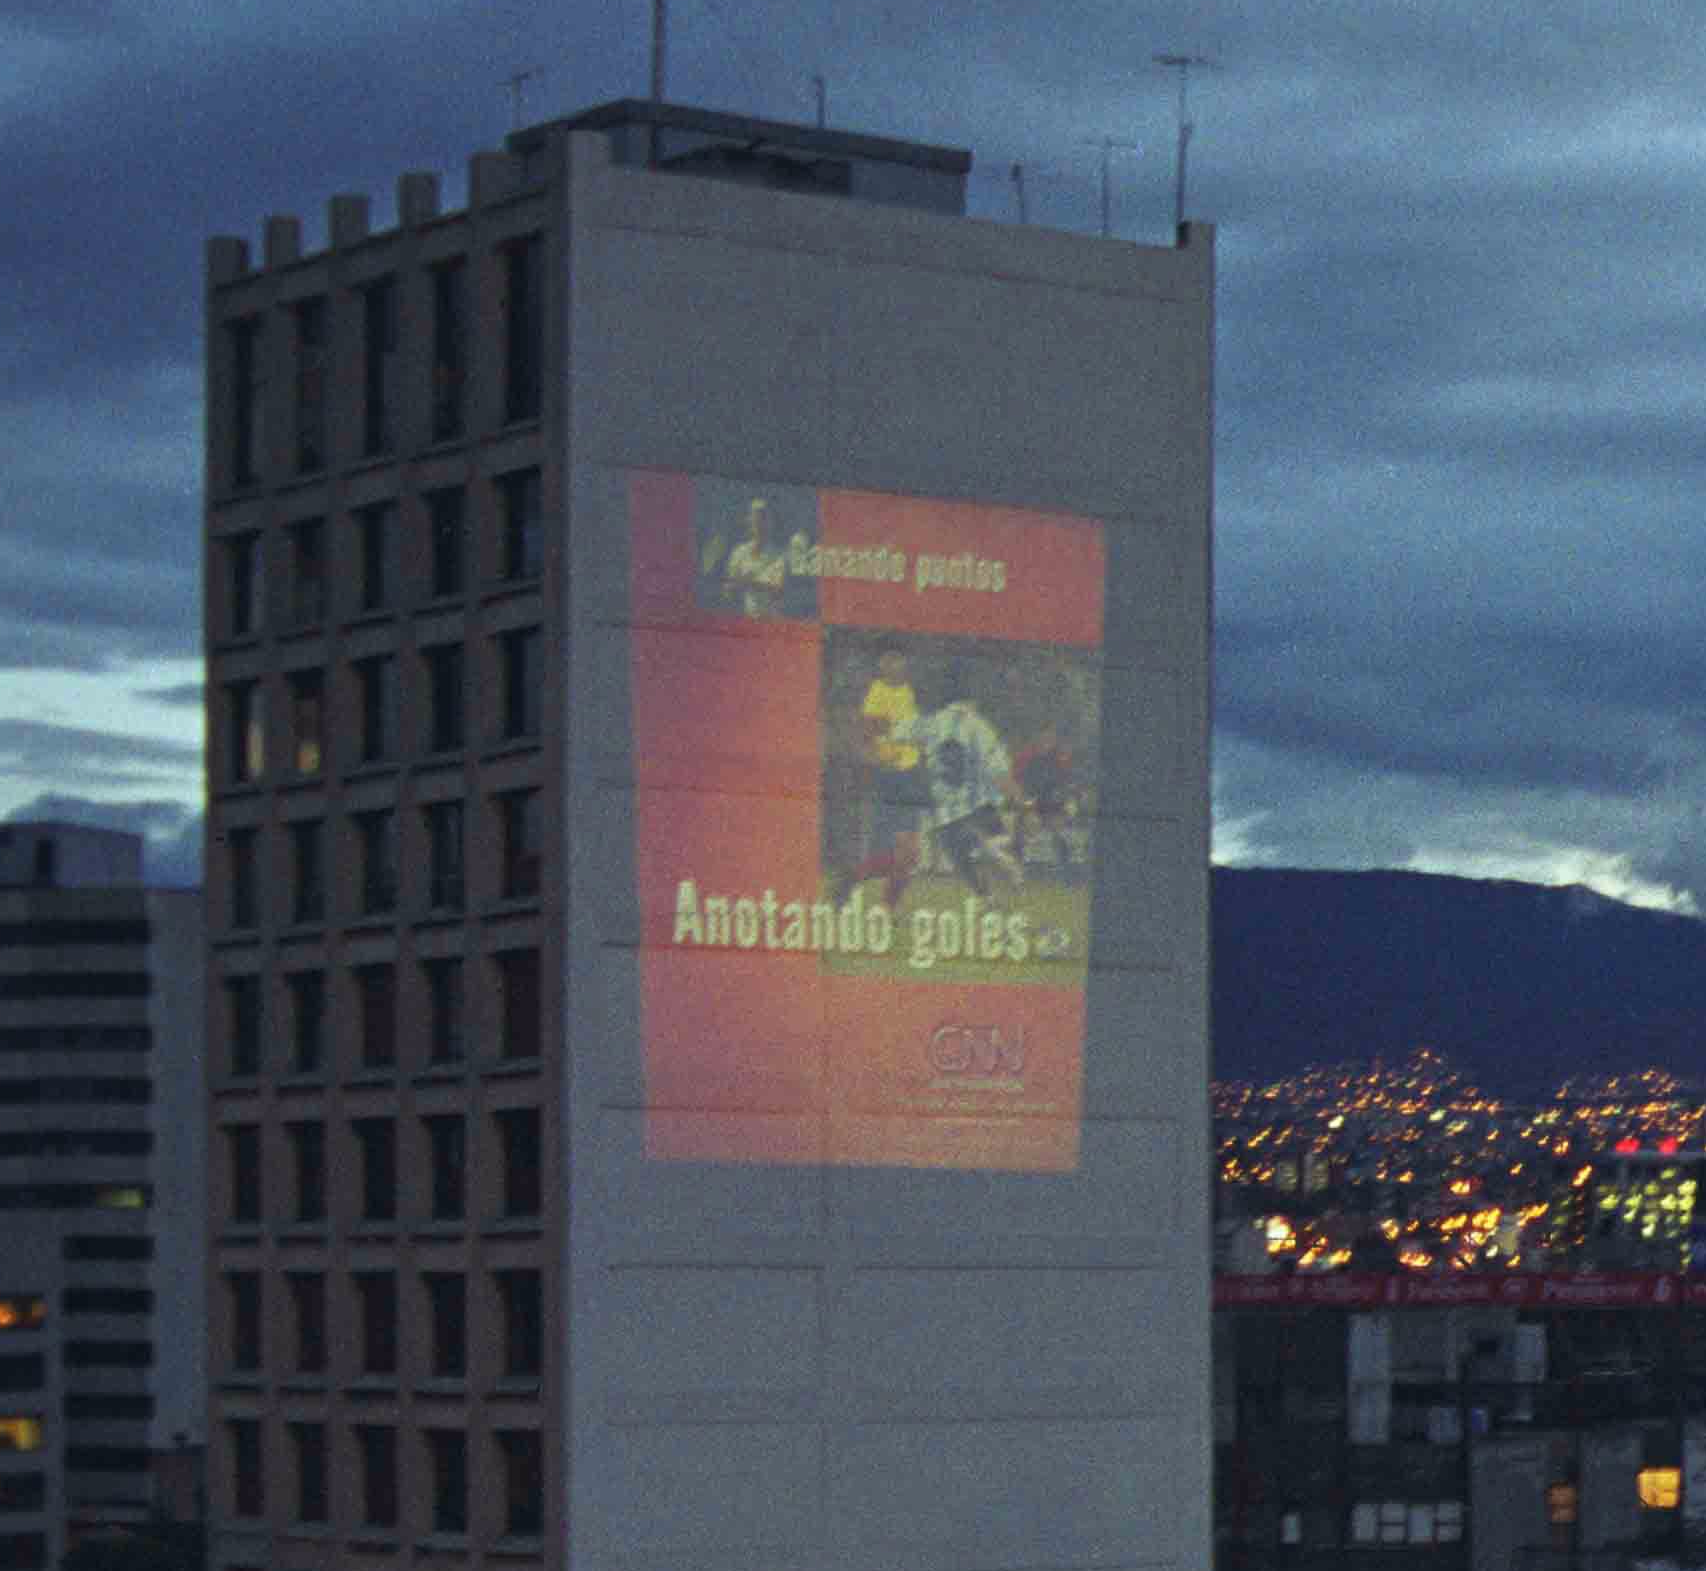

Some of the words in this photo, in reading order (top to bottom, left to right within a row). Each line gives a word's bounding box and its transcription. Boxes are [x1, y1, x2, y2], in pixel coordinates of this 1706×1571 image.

[790, 532, 906, 583] Ganando
[916, 552, 1008, 592] puntos
[672, 880, 893, 954] Anotando
